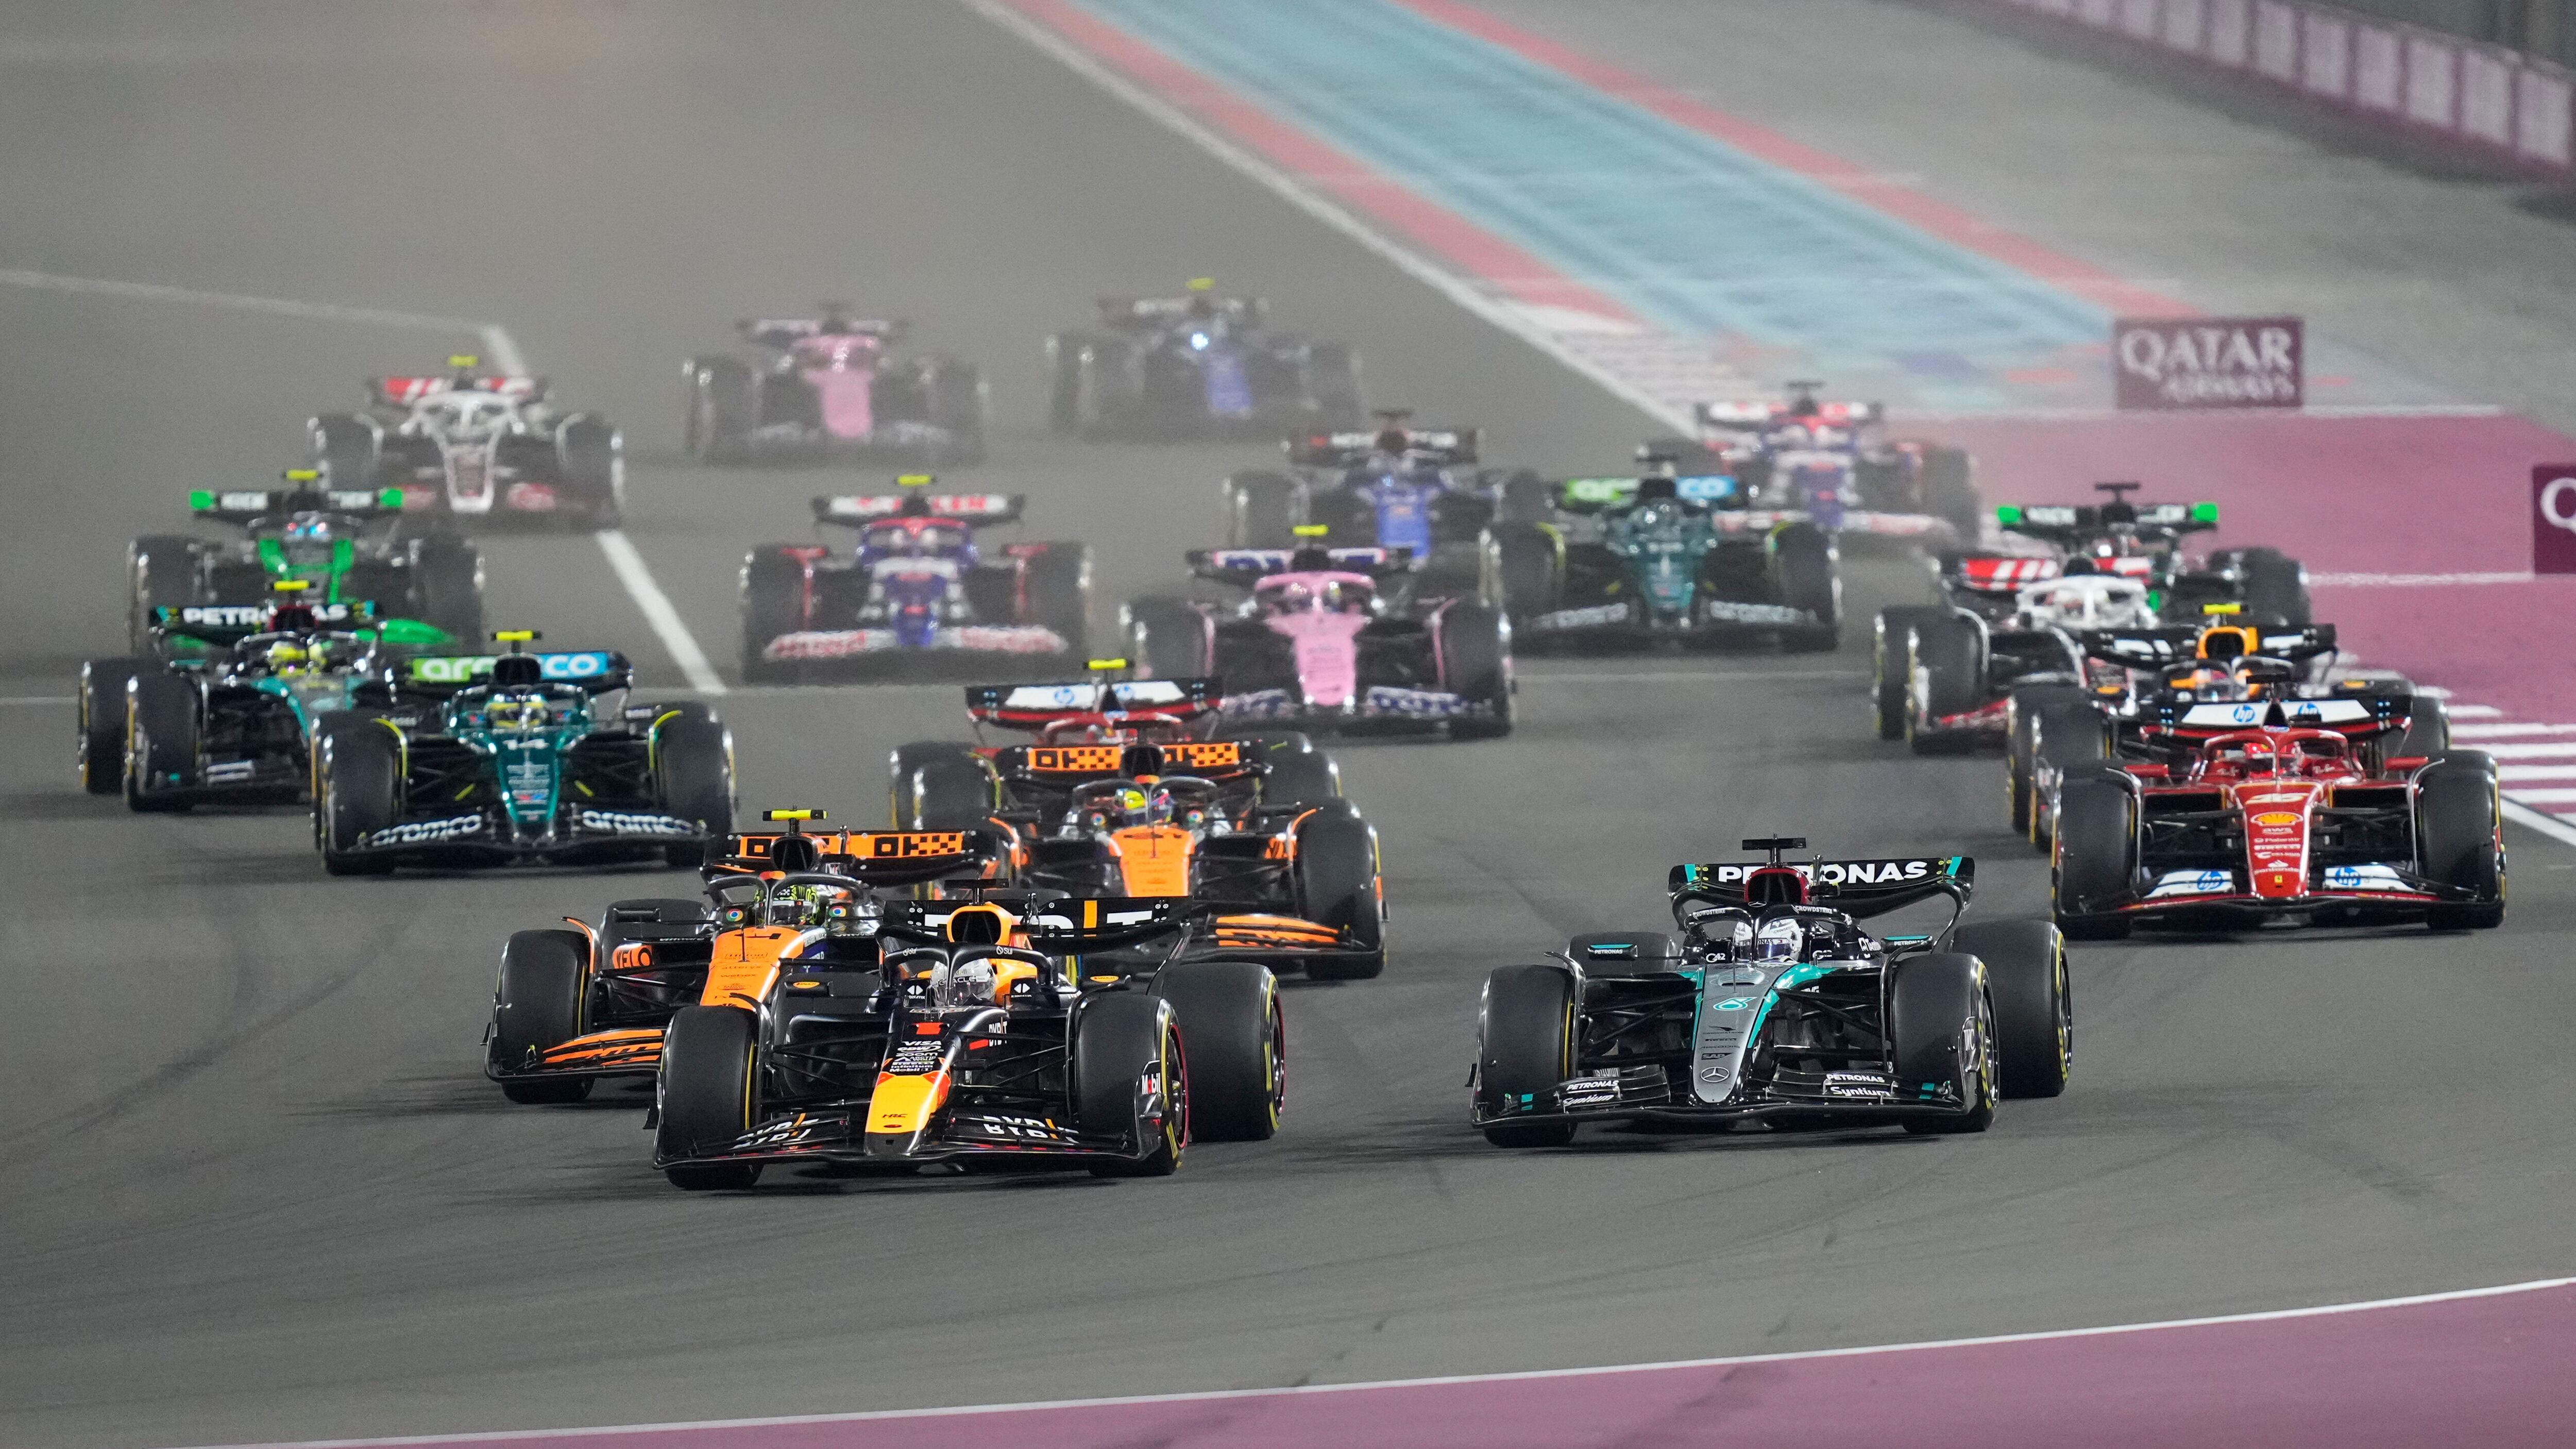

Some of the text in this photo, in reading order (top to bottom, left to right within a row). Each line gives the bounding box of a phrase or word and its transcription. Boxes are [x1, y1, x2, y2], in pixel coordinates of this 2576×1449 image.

[2120, 328, 2294, 381] QATAR
[183, 604, 349, 624] PETRAS
[421, 654, 599, 679] arco
[371, 815, 482, 847] aramco
[583, 810, 693, 835] aramco
[1795, 905, 1833, 914] CROWDSTRIKE
[616, 948, 653, 968] VELO
[1705, 953, 1726, 963] G42
[1141, 1072, 1161, 1095] Mobil
[1566, 1080, 1619, 1091] PETRONAS
[1824, 1073, 1885, 1083] PETRONAS
[1562, 1094, 1614, 1106] Syntium
[1830, 1086, 1890, 1097] Syntium
